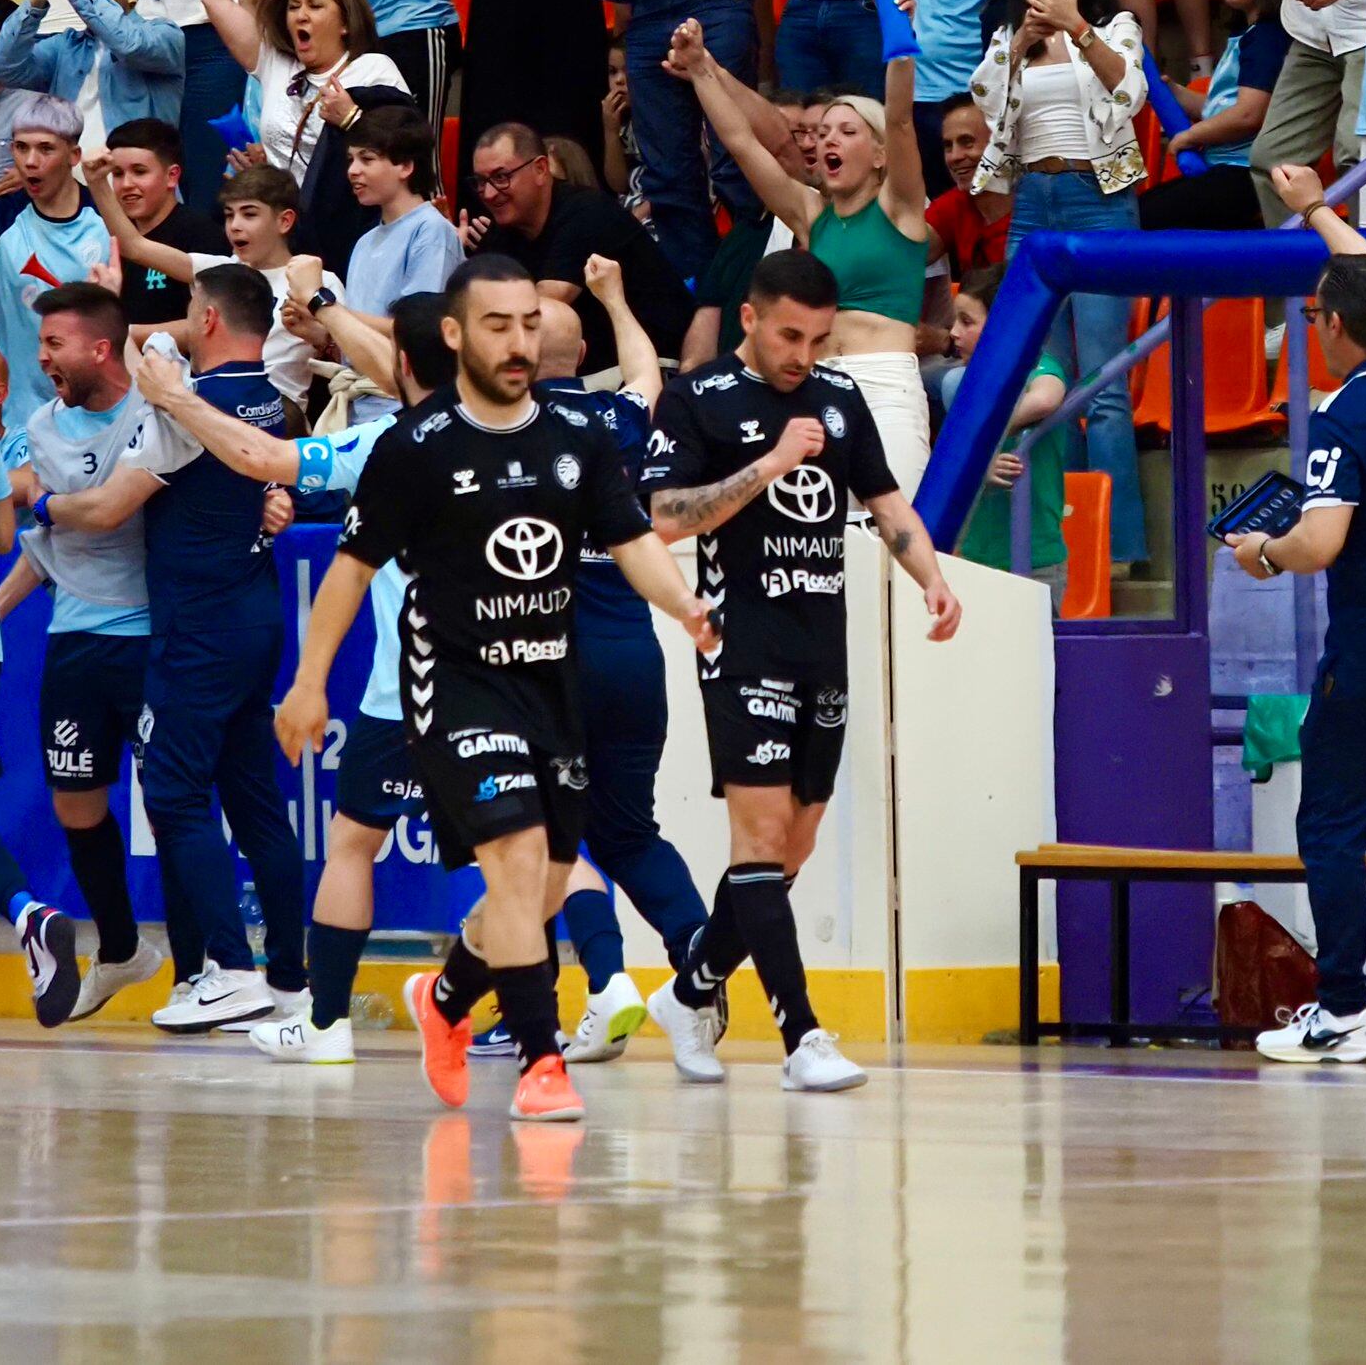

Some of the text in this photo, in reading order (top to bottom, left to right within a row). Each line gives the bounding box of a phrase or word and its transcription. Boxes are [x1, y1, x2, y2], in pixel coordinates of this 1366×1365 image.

[302, 442, 329, 461] C
[82, 453, 98, 475] 3
[382, 780, 425, 800] caja
